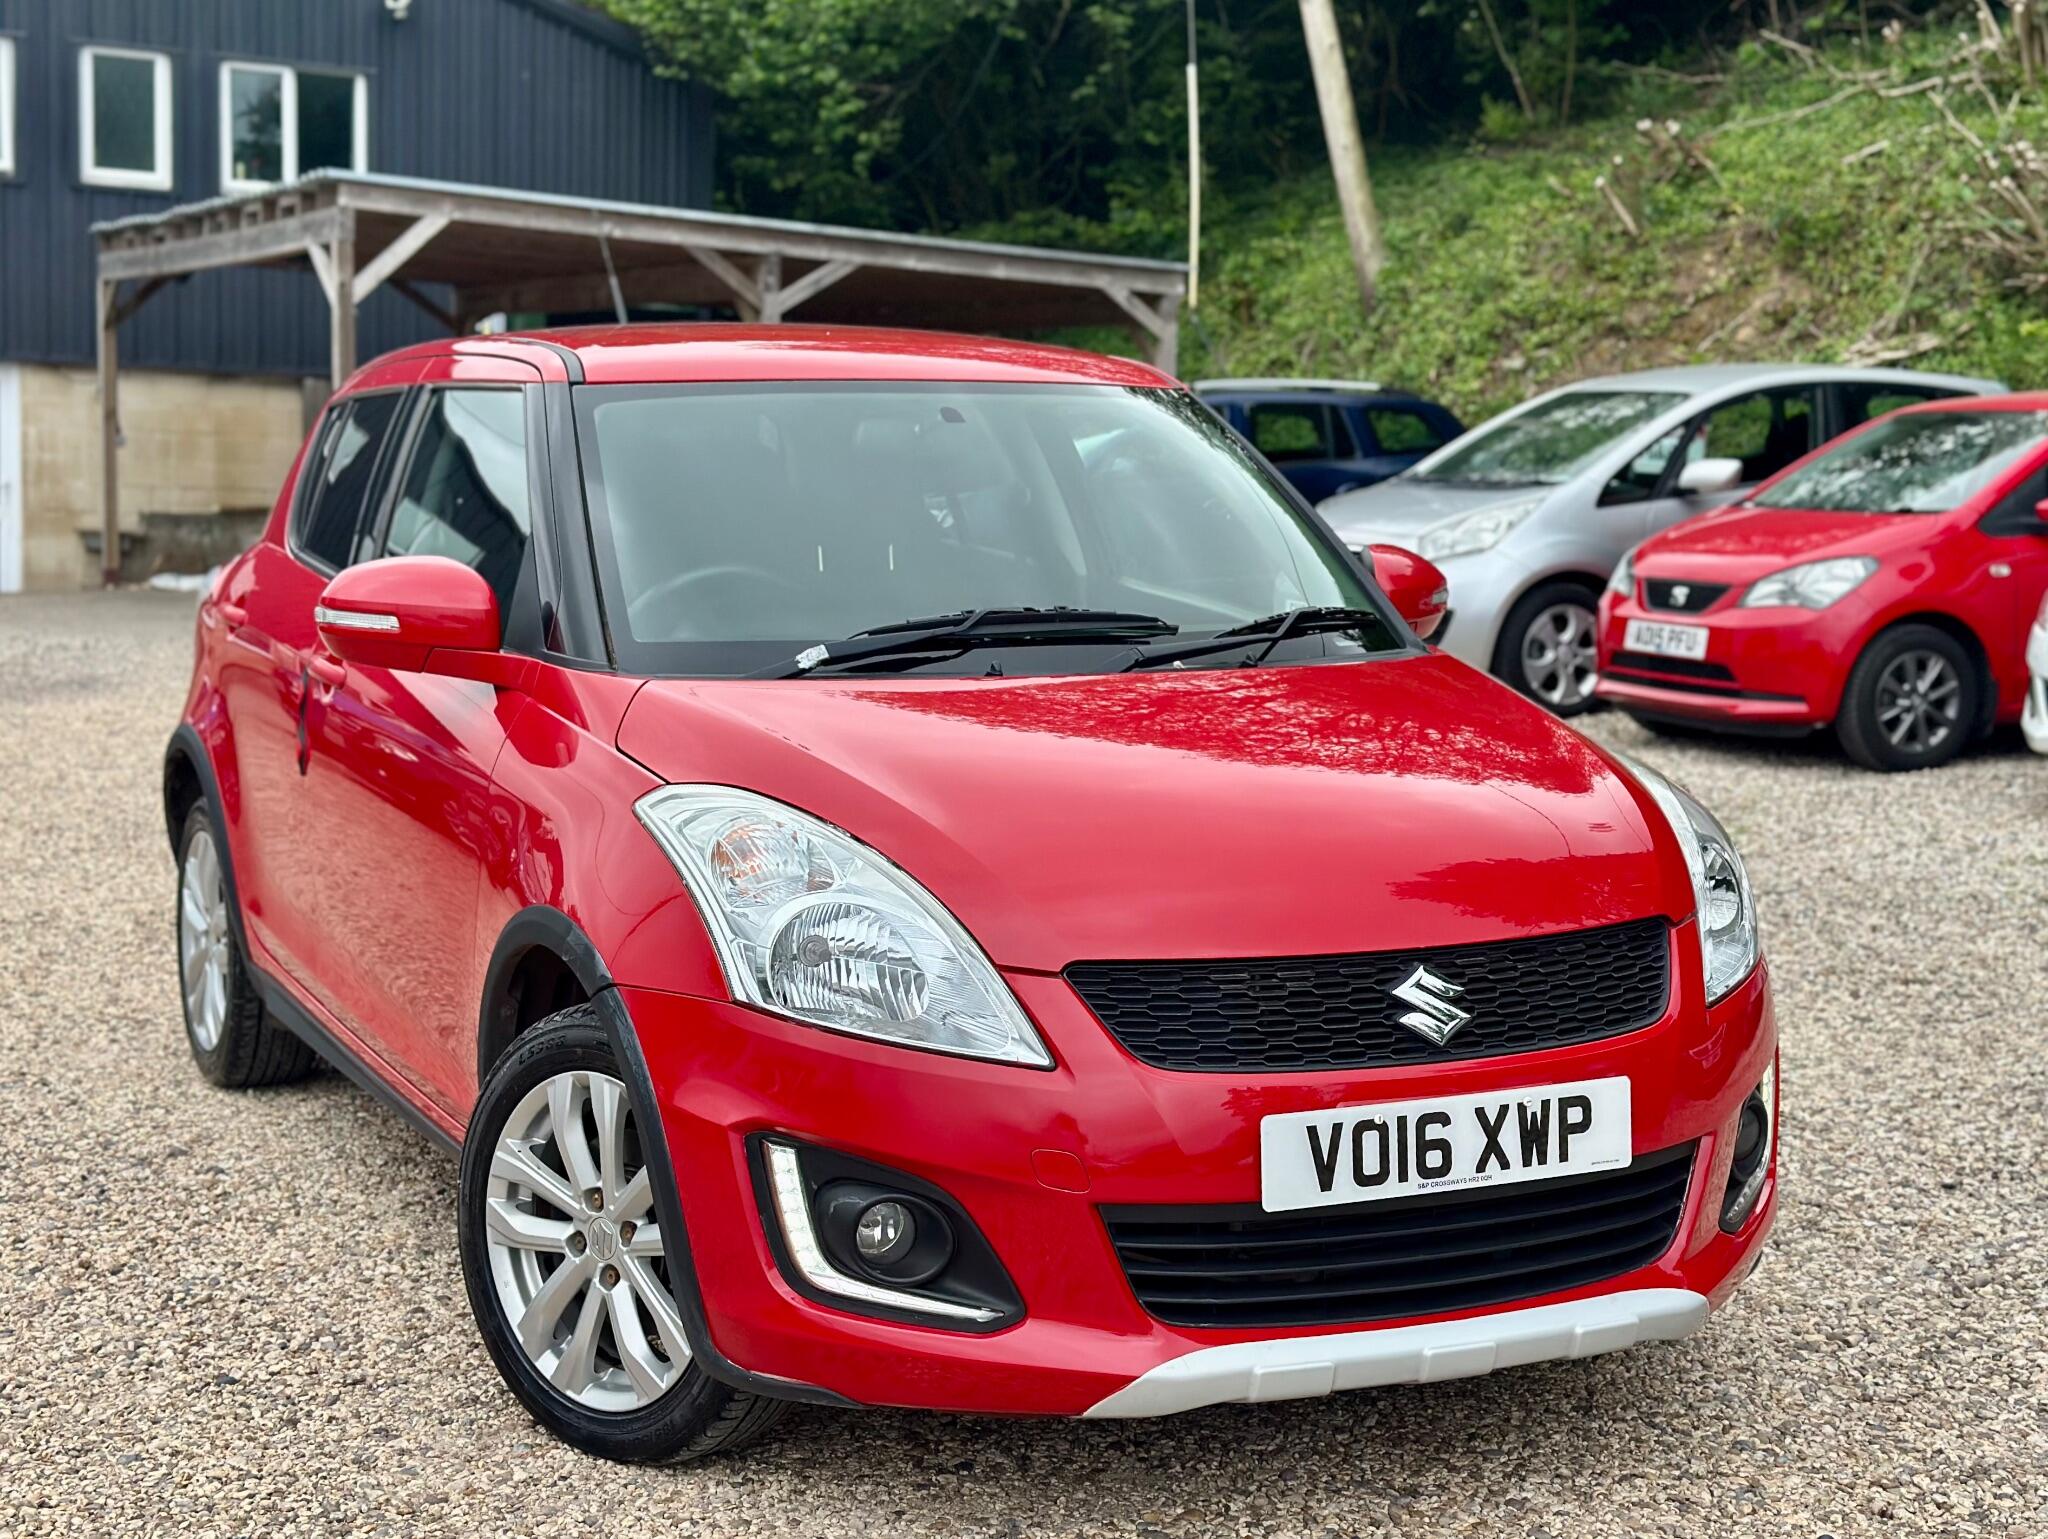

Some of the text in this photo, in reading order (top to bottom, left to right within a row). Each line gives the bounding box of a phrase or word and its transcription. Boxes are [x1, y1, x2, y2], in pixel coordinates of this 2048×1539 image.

[1306, 1094, 1593, 1193] VO16 XWP
[1417, 1182, 1430, 1190] S&P
[1430, 1177, 1468, 1188] CROSSWAYS
